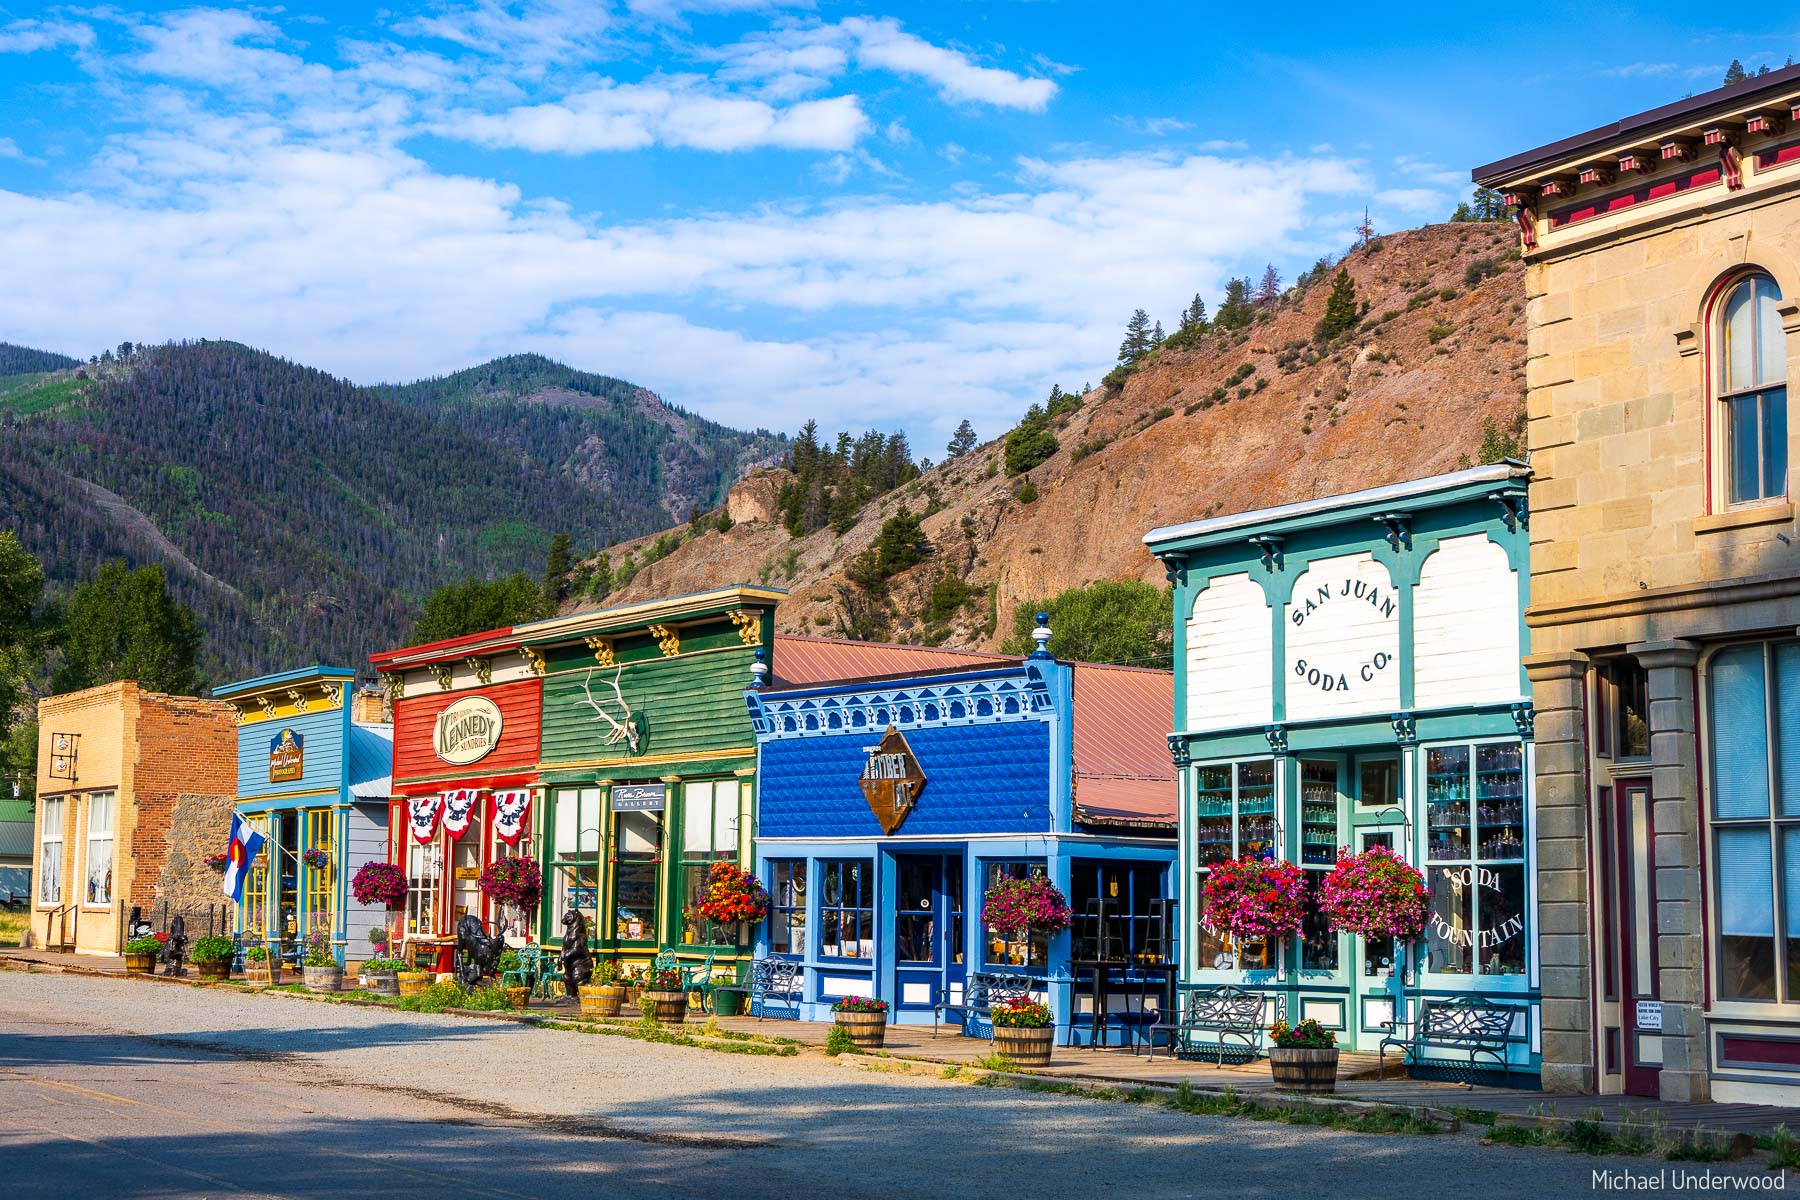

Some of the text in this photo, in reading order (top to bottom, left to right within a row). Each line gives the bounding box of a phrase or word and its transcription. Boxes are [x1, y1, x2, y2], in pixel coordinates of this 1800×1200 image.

[1292, 579, 1396, 627] SAN JUAN
[1294, 652, 1392, 691] SODA CO.
[438, 714, 496, 754] KENNEDY
[460, 737, 487, 751] SUNDRIES
[862, 746, 907, 779] TIMBER
[1451, 868, 1501, 892] SODA
[1431, 910, 1524, 948] FOUNTAIN
